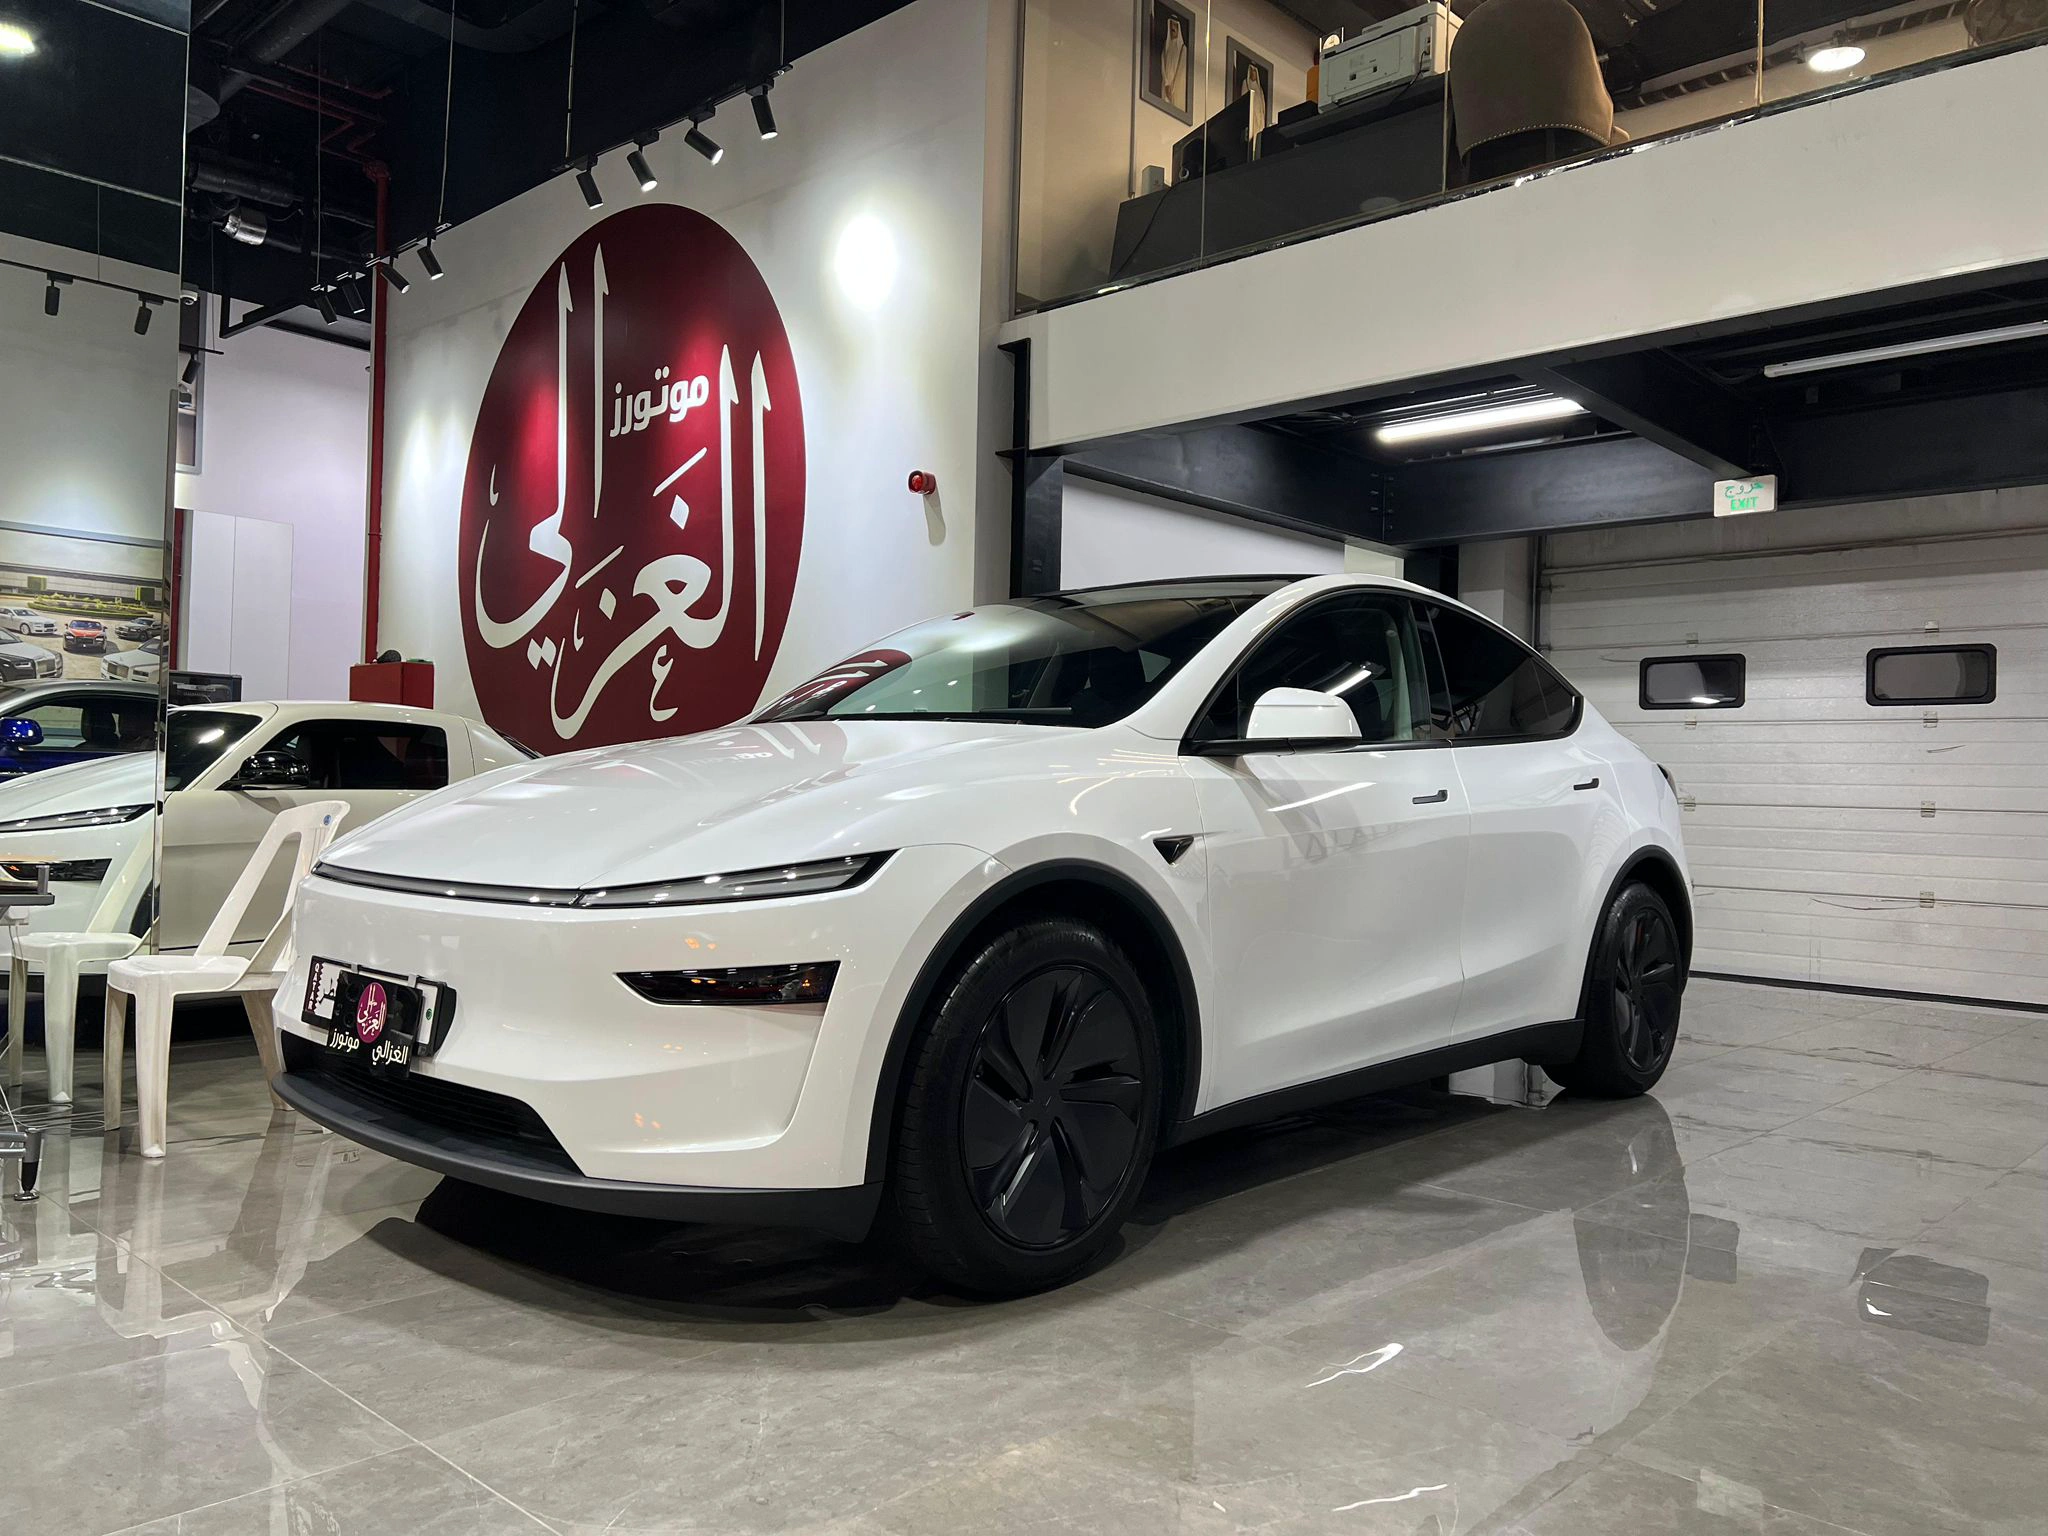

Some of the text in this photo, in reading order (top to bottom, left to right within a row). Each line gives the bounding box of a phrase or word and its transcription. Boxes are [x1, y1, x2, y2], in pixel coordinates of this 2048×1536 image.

[609, 366, 710, 438] موتورز
[1725, 480, 1765, 498] خروج
[1731, 496, 1758, 511] EXIT
[308, 963, 320, 1010] QATAR
[329, 1028, 409, 1066] الغزالي موتورز
